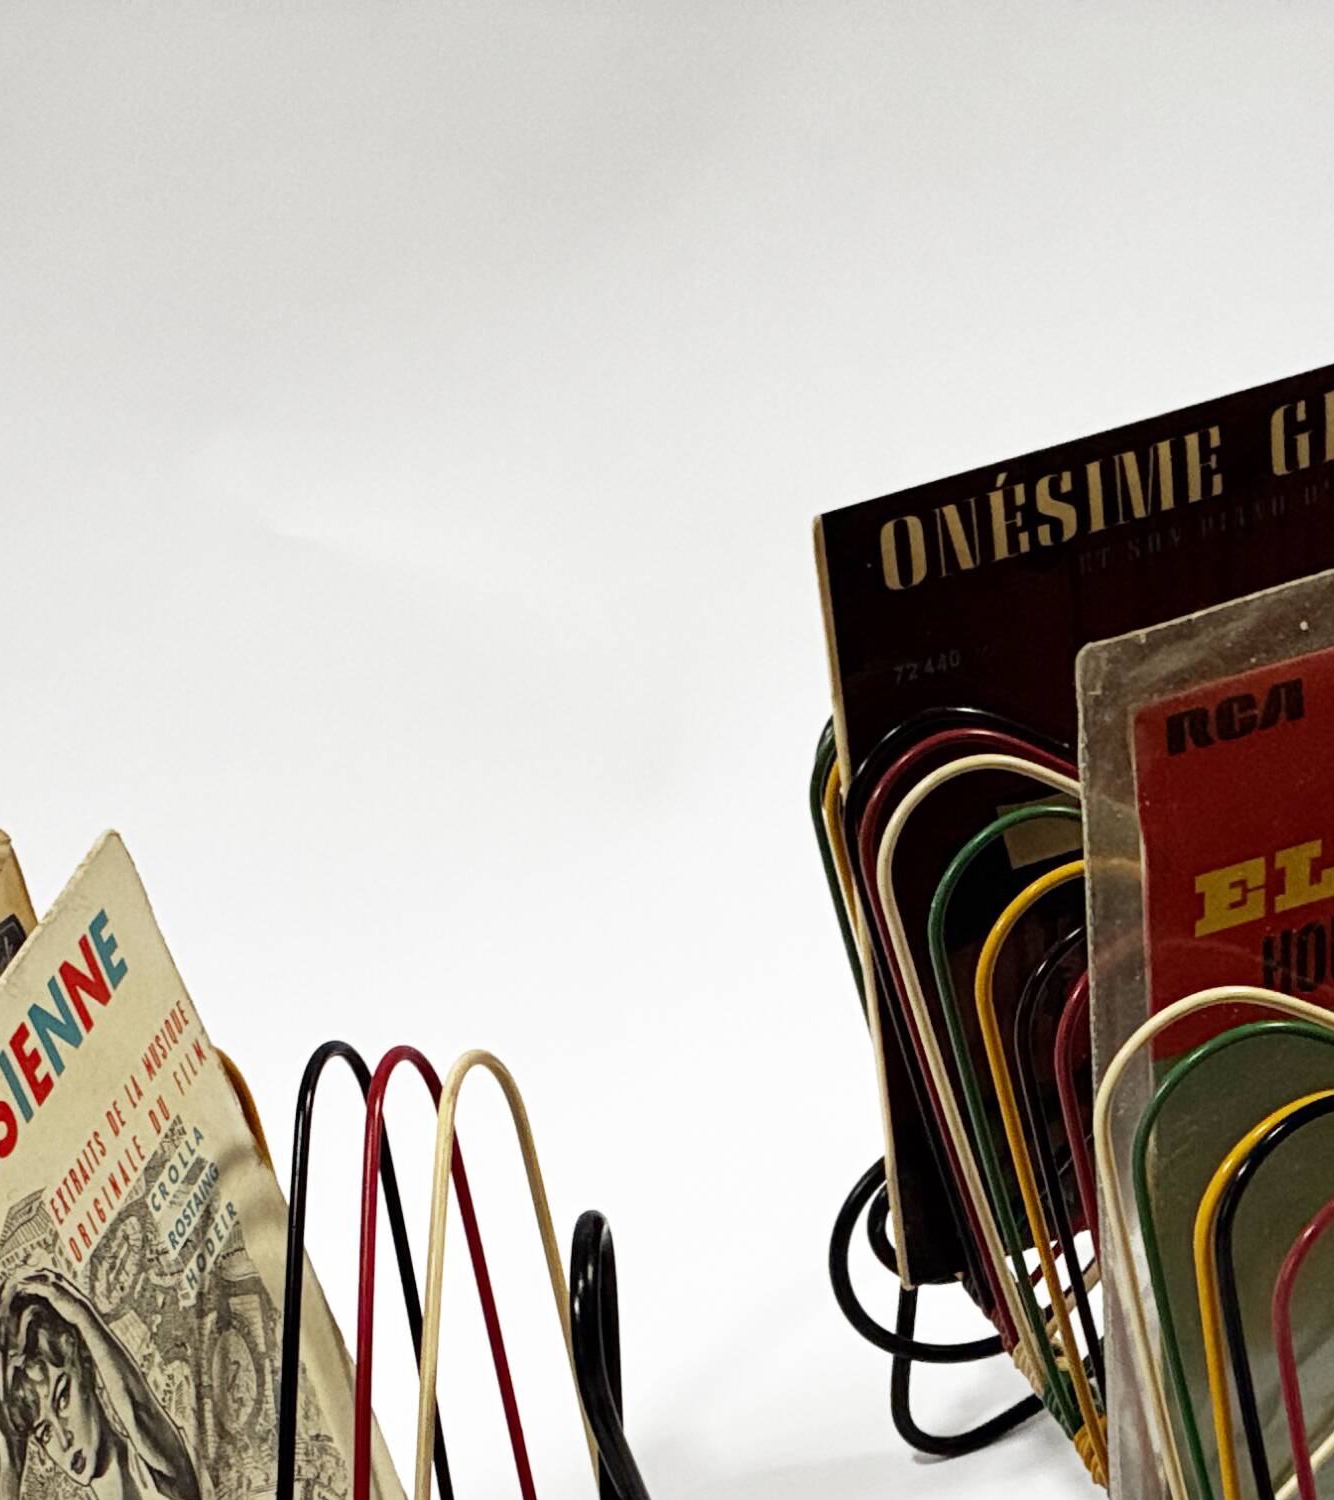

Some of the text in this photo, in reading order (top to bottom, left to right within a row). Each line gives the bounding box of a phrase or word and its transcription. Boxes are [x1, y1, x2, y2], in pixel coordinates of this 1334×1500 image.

[879, 425, 1224, 591] ONÉSIME
[1166, 676, 1305, 757] RCA
[50, 1000, 190, 1226] EXTRAITS DE LA MUSIQUE
[68, 1042, 207, 1262] ORIGINALE DU FILM
[150, 1127, 205, 1212] CROLLA
[167, 1162, 220, 1249] ROSTAING
[185, 1200, 239, 1287] HODEIR
